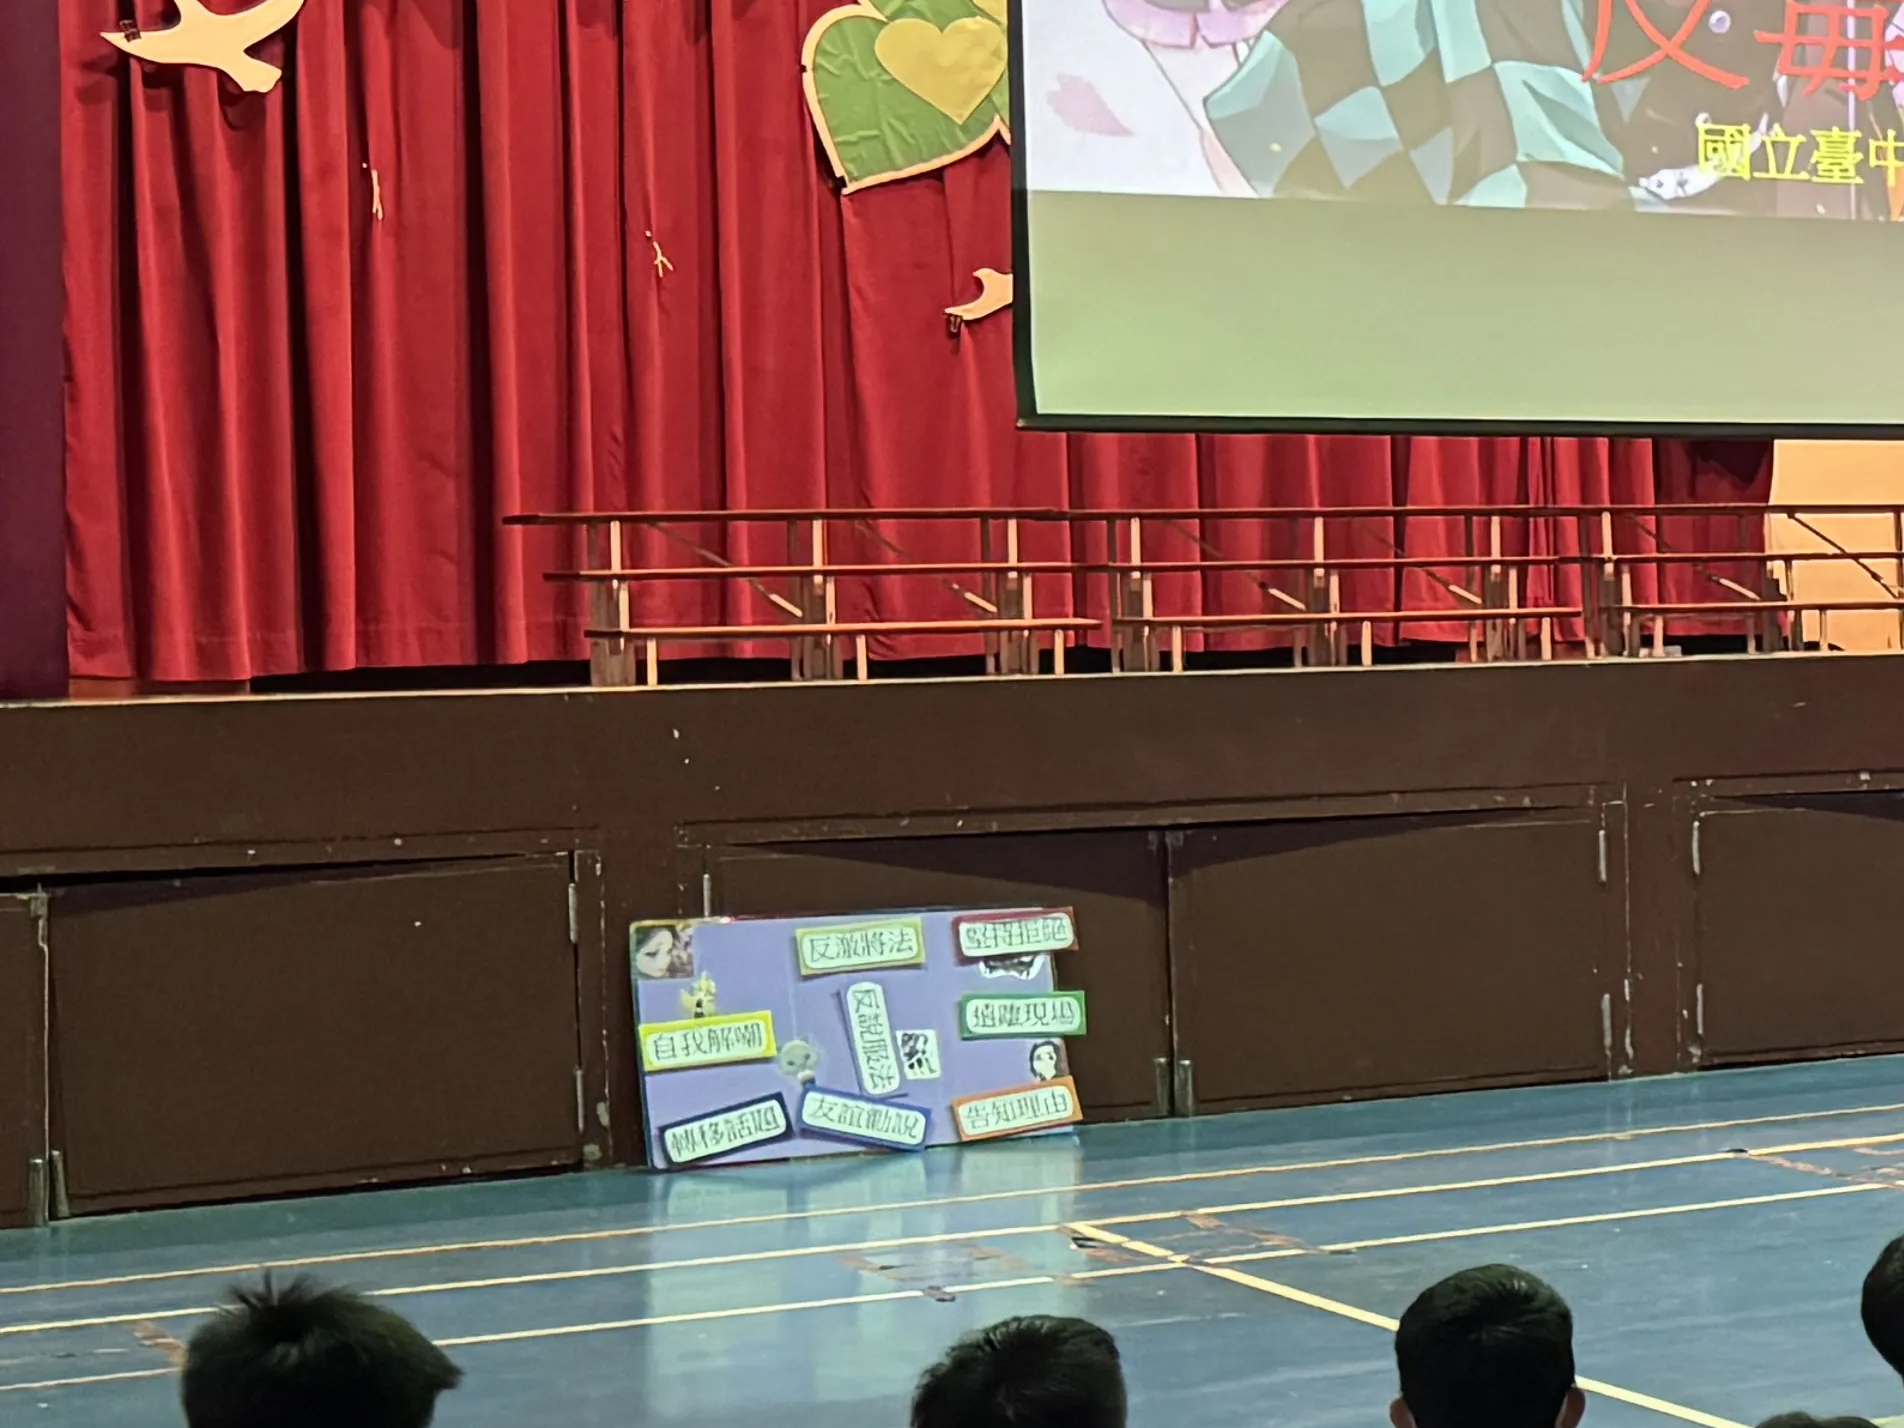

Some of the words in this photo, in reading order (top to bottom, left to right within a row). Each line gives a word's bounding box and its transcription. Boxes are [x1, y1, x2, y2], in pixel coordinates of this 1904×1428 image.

[809, 927, 914, 963] 反激將法
[653, 1022, 763, 1061] 自我解嘲
[965, 1089, 1068, 1130] 告知理由
